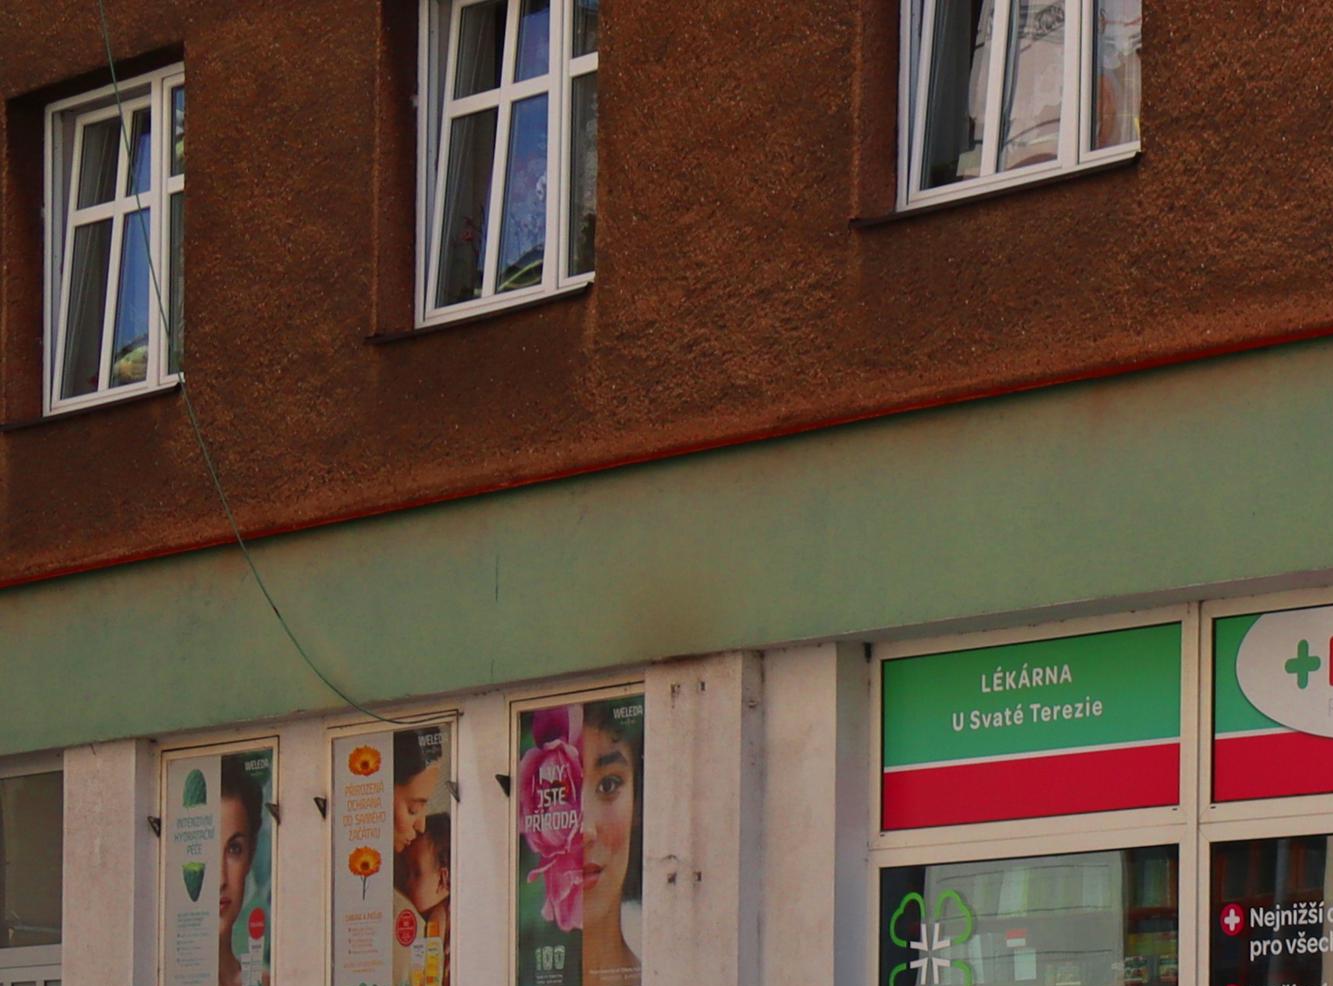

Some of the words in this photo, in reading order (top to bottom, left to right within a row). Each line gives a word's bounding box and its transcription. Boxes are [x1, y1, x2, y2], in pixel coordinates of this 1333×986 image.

[980, 663, 1073, 693] LÉKÁRNA
[613, 704, 643, 719] WELEDA
[952, 713, 965, 732] U
[970, 704, 1025, 730] Svaté
[1032, 696, 1104, 723] Terezie
[537, 787, 566, 808] JSTE
[525, 809, 578, 833] PŘÍRODA
[1250, 901, 1325, 931] Nejnižší
[1250, 937, 1283, 962] pro
